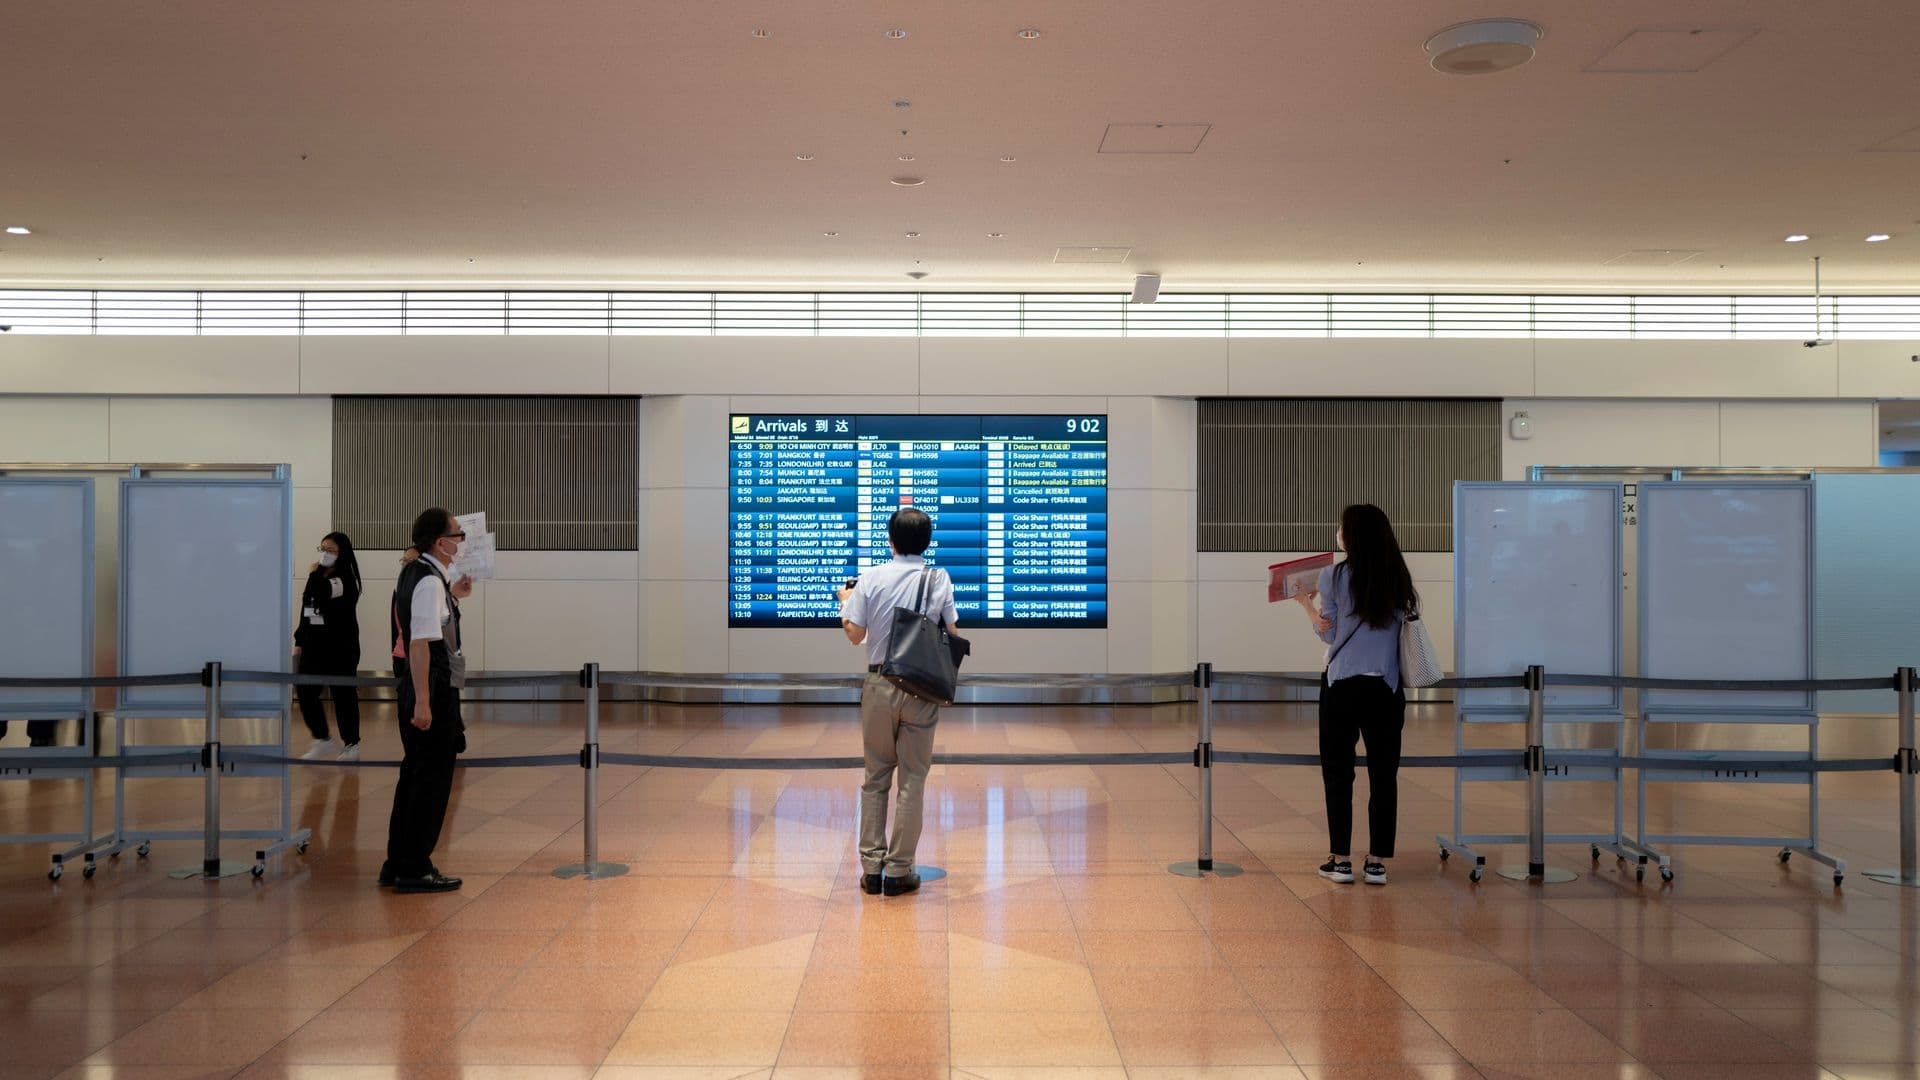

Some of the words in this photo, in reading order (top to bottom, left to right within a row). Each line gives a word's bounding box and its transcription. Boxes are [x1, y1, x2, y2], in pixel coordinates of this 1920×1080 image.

[756, 419, 807, 432] Arrivals
[1067, 419, 1076, 432] 9
[1081, 419, 1099, 432] 02
[1013, 452, 1040, 460] Baggage
[1013, 470, 1040, 478] Baggage
[1013, 479, 1040, 487] Baggage
[1013, 566, 1029, 574] Code
[1031, 566, 1048, 574] Share
[735, 584, 751, 592] 12:55
[802, 584, 828, 592] CAPITAL
[1013, 584, 1029, 592] Code
[1031, 584, 1048, 592] Share
[1013, 602, 1029, 610] Code
[1031, 602, 1048, 610] Share
